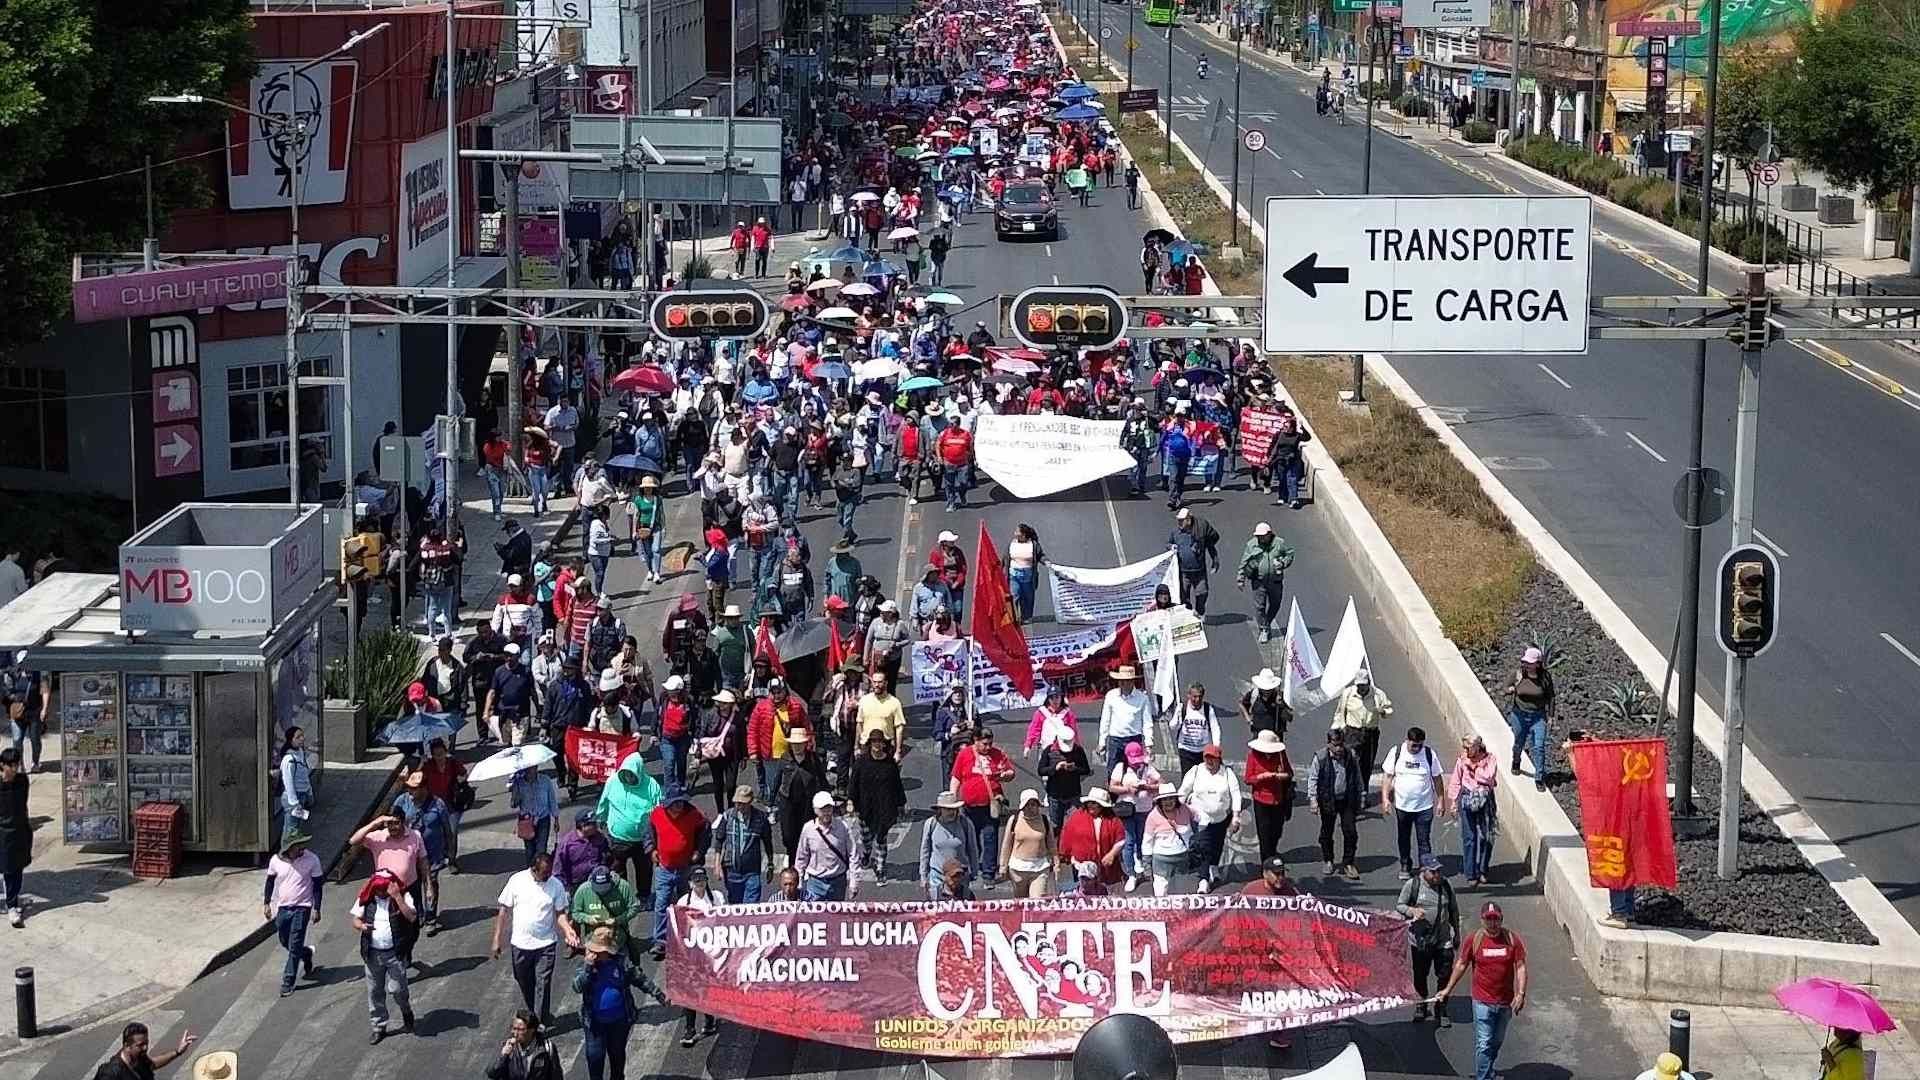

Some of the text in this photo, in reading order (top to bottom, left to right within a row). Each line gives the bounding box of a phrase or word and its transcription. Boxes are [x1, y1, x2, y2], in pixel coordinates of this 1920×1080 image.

[1365, 228, 1574, 261] TRANSPORTE
[1365, 289, 1569, 322] DE CARGA
[124, 568, 266, 605] MB100
[1044, 642, 1090, 655] TOTAL
[880, 899, 981, 914] NACIONAL
[985, 900, 1014, 912] DE
[1021, 896, 1184, 912] TRABAJADORES
[1189, 895, 1220, 910] DE
[1223, 895, 1251, 910] LA
[1255, 895, 1371, 927] EDUCACIÓN
[684, 921, 919, 949] JORNADA DE LUCHA
[741, 957, 861, 983] NACIONAL
[917, 919, 1170, 1020] CNTE
[1312, 1011, 1336, 1022] DEL
